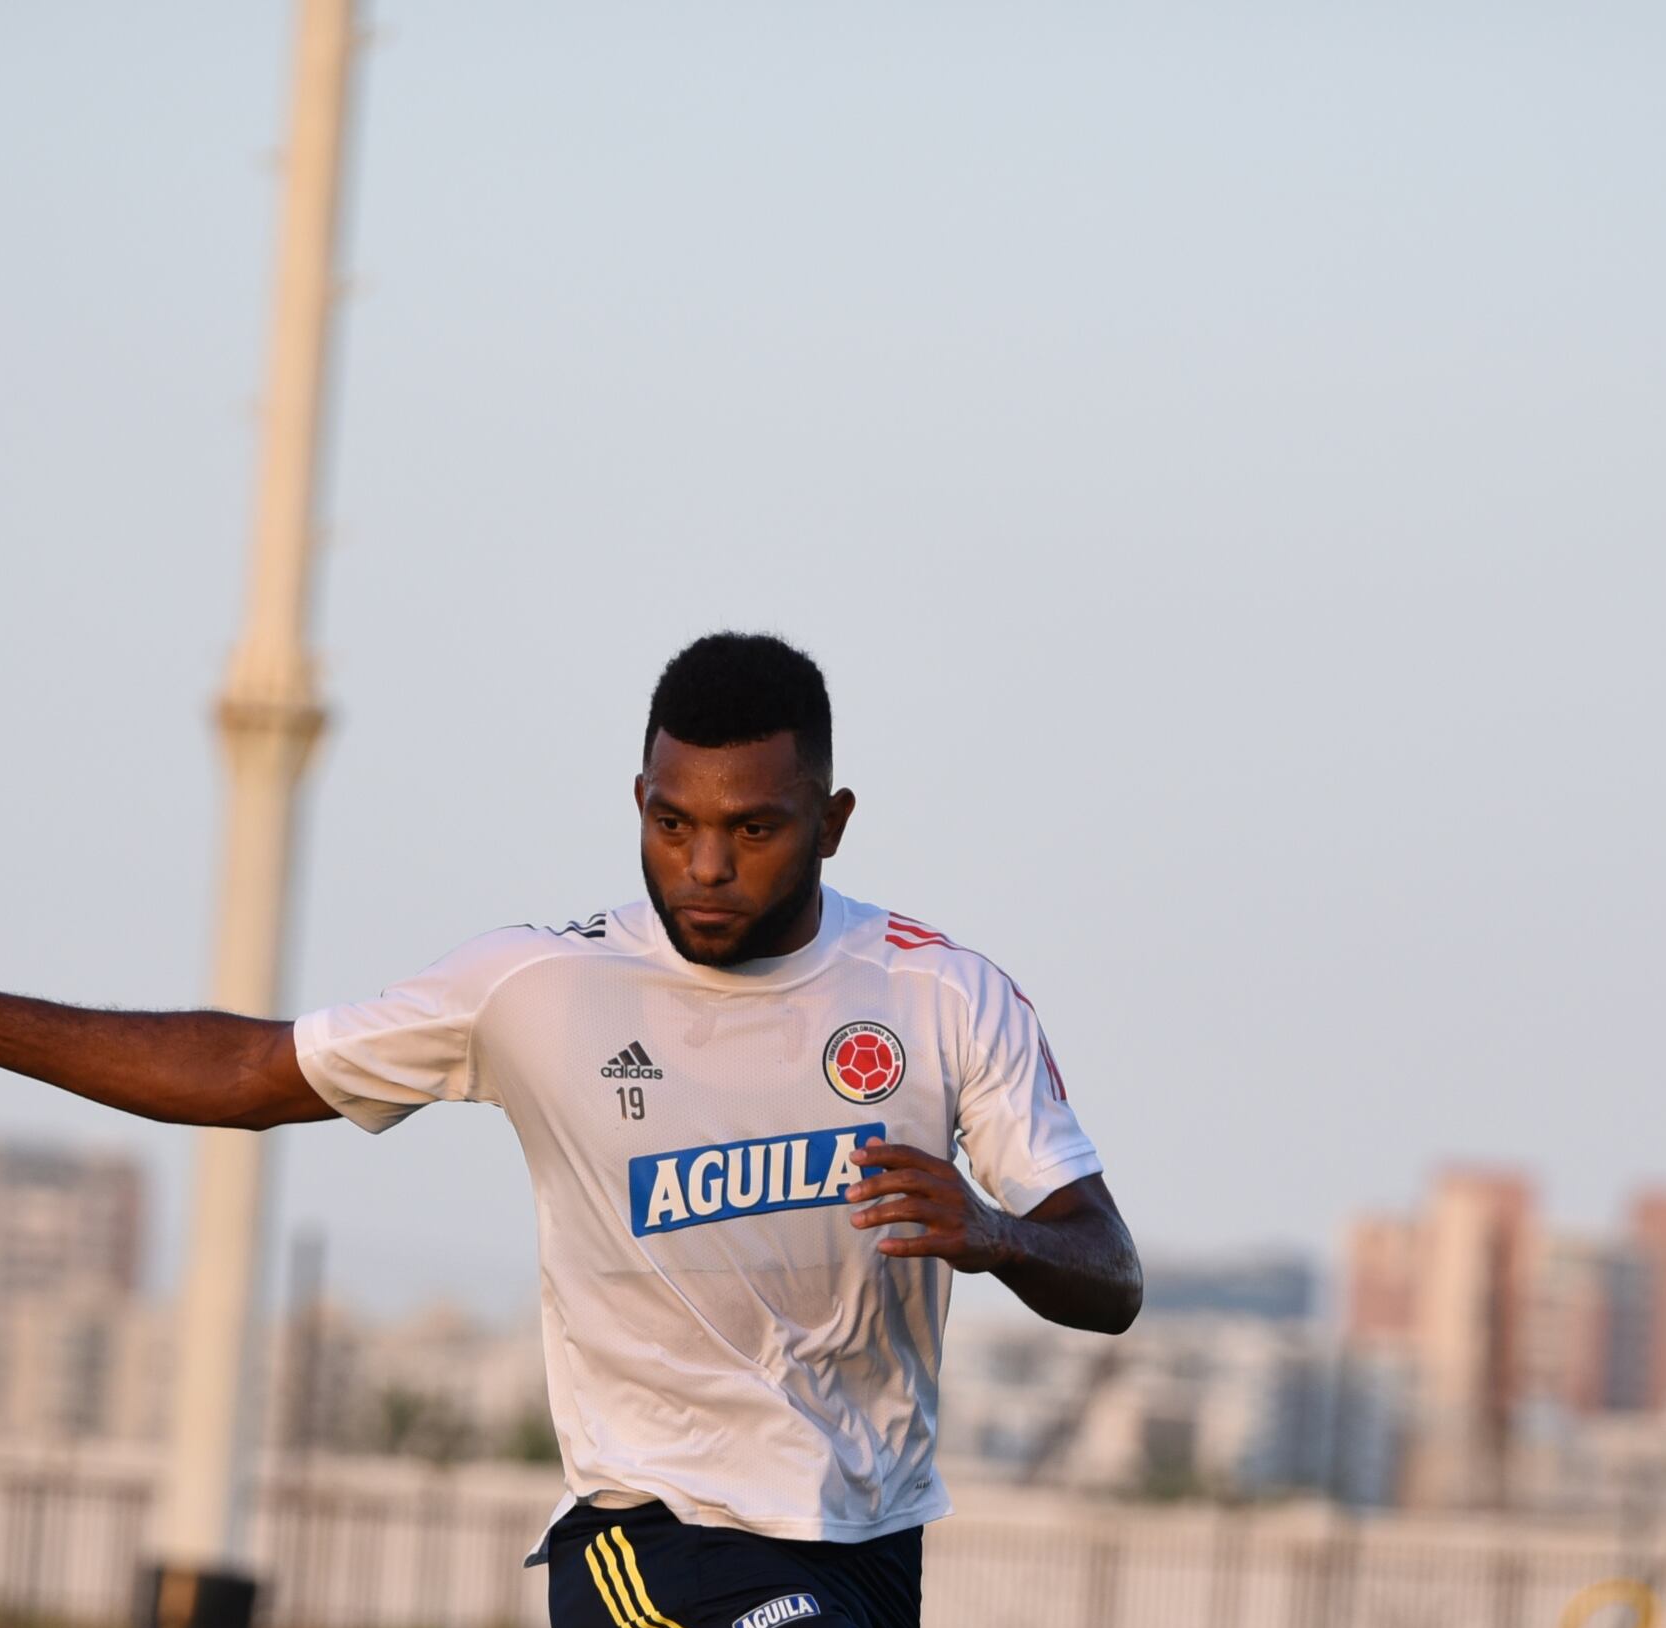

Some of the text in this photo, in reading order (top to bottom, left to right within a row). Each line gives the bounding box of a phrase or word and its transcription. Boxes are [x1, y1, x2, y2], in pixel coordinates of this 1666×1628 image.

[600, 1064, 663, 1080] adidas
[616, 1086, 645, 1120] 19
[644, 1133, 864, 1227] AGUILA
